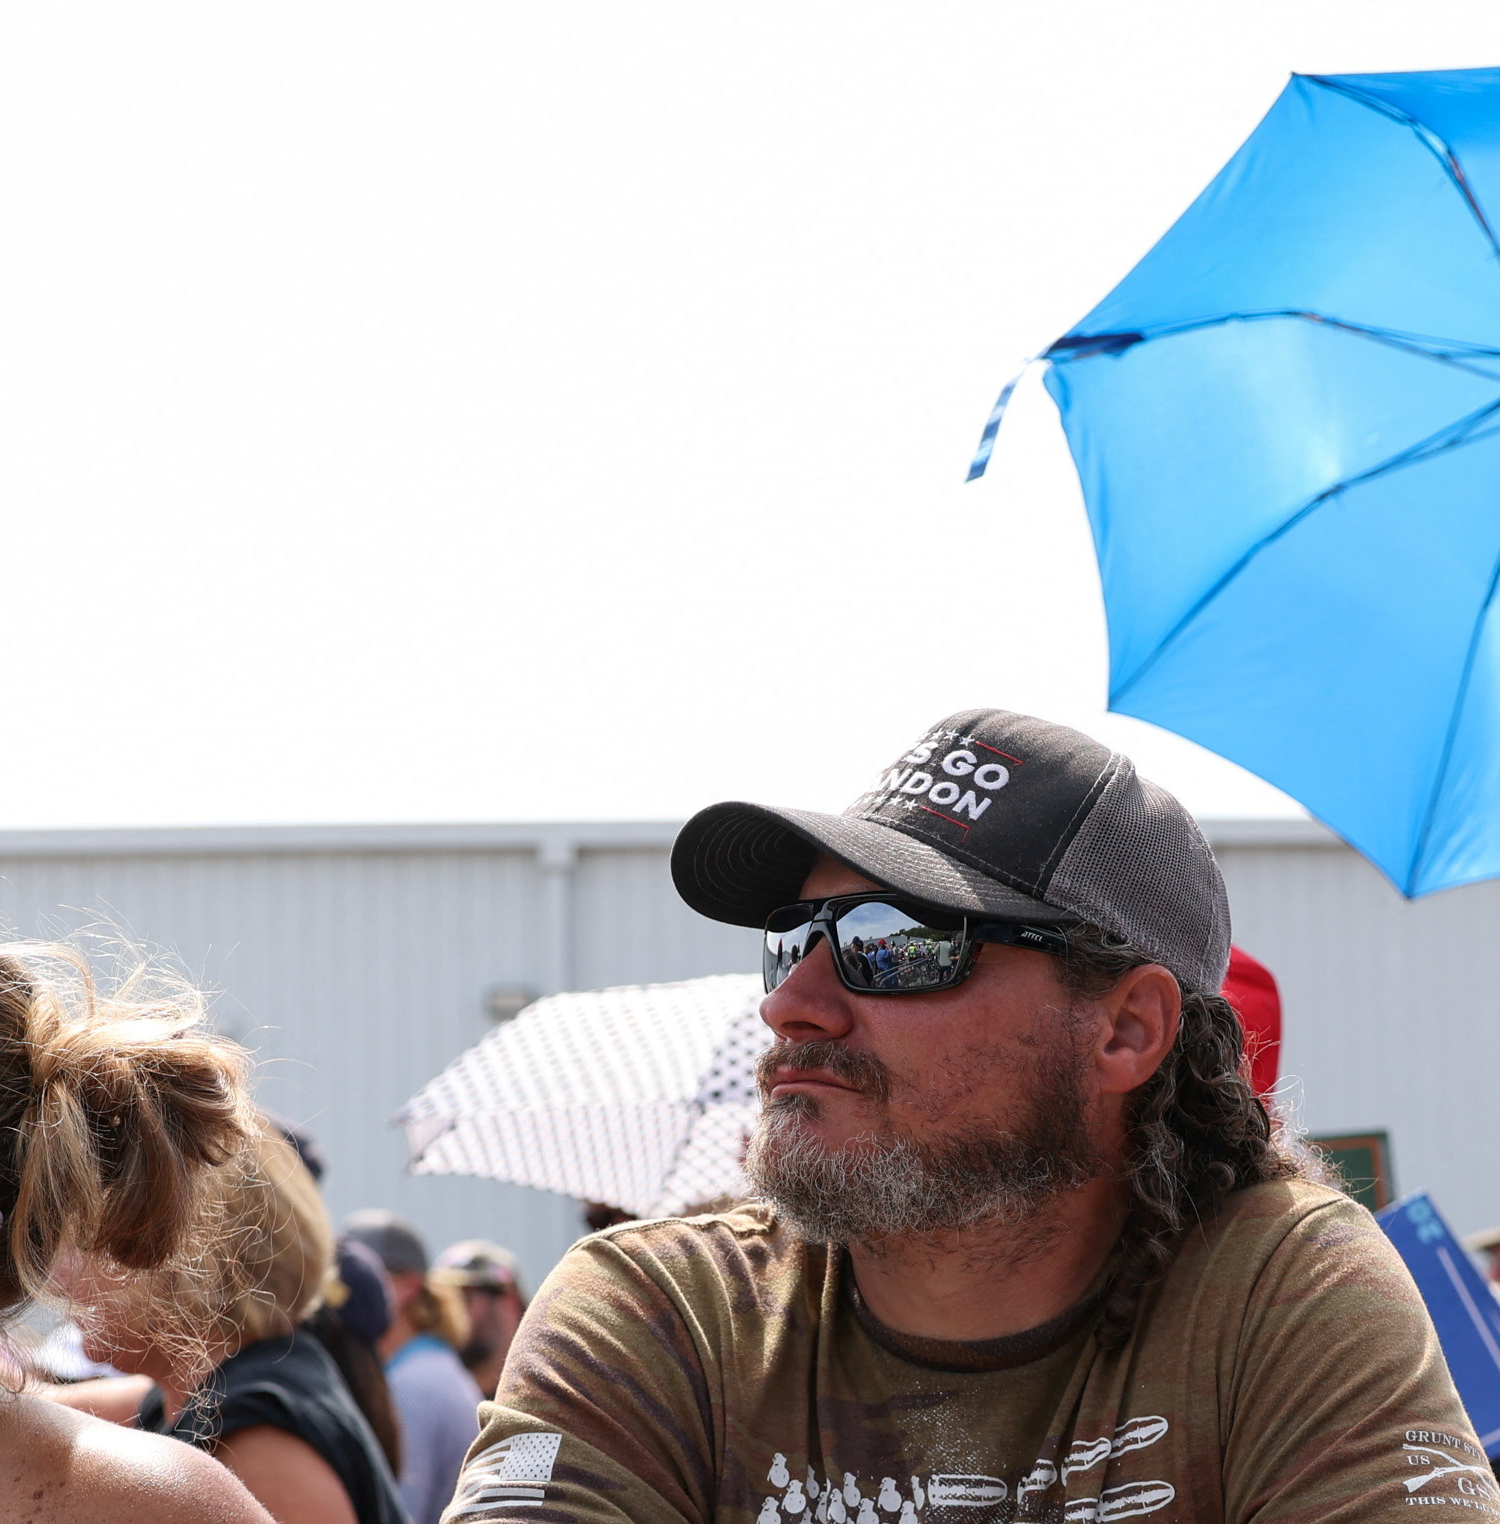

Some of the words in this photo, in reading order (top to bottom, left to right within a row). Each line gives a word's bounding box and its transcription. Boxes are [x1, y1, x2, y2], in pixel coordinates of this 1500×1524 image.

[941, 749, 1010, 791] GO
[874, 768, 993, 821] NDON
[1405, 1429, 1461, 1448] GRUNT
[1406, 1455, 1431, 1466] US
[1457, 1477, 1491, 1502] GS
[1405, 1496, 1446, 1506] THIS
